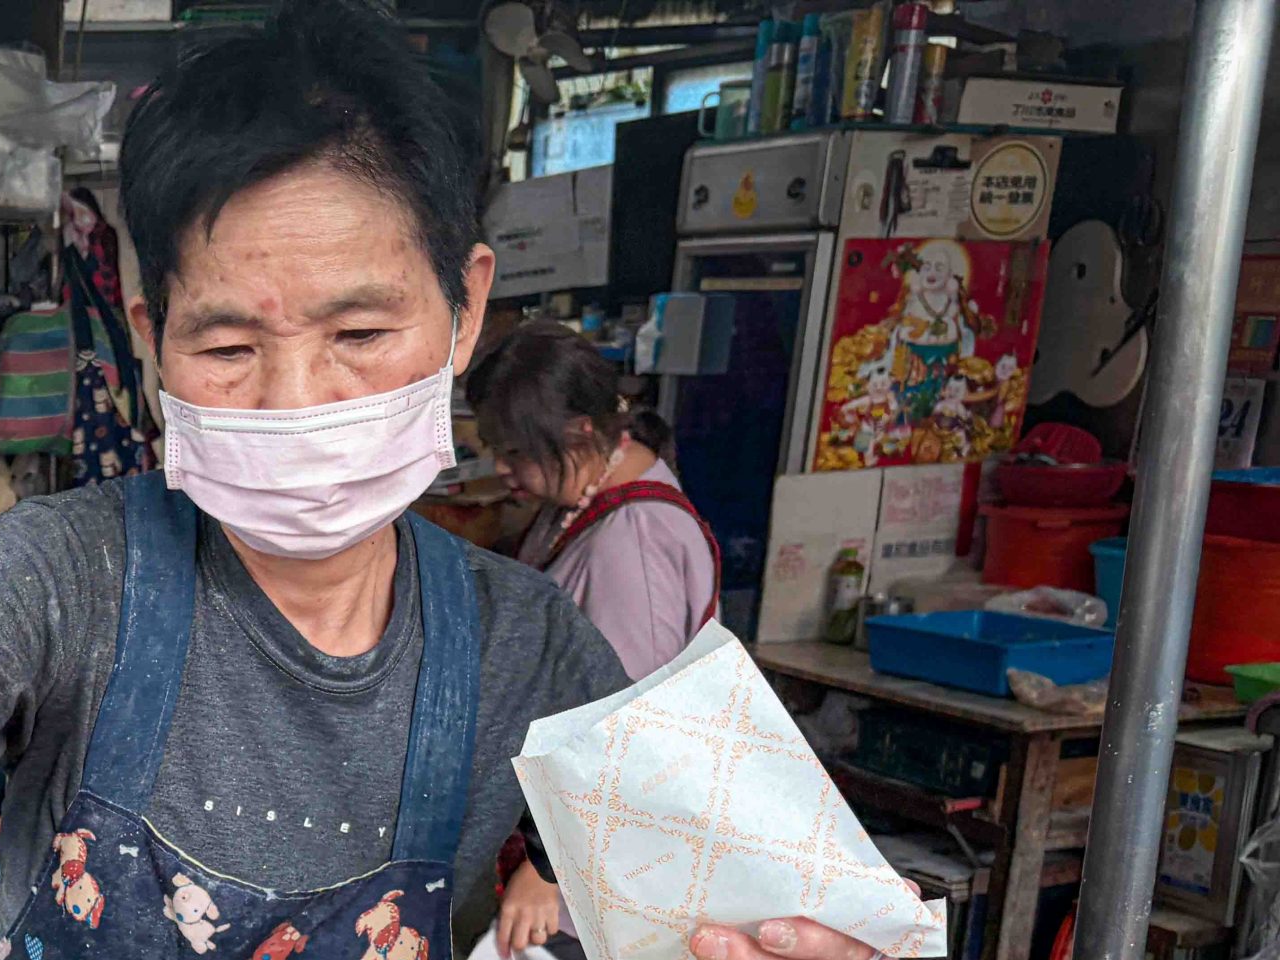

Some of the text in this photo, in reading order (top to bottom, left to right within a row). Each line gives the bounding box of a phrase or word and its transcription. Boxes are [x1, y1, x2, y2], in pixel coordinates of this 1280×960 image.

[204, 800, 386, 838] SISLEY
[623, 851, 674, 880] THANK YOU
[873, 903, 895, 918] YOU
